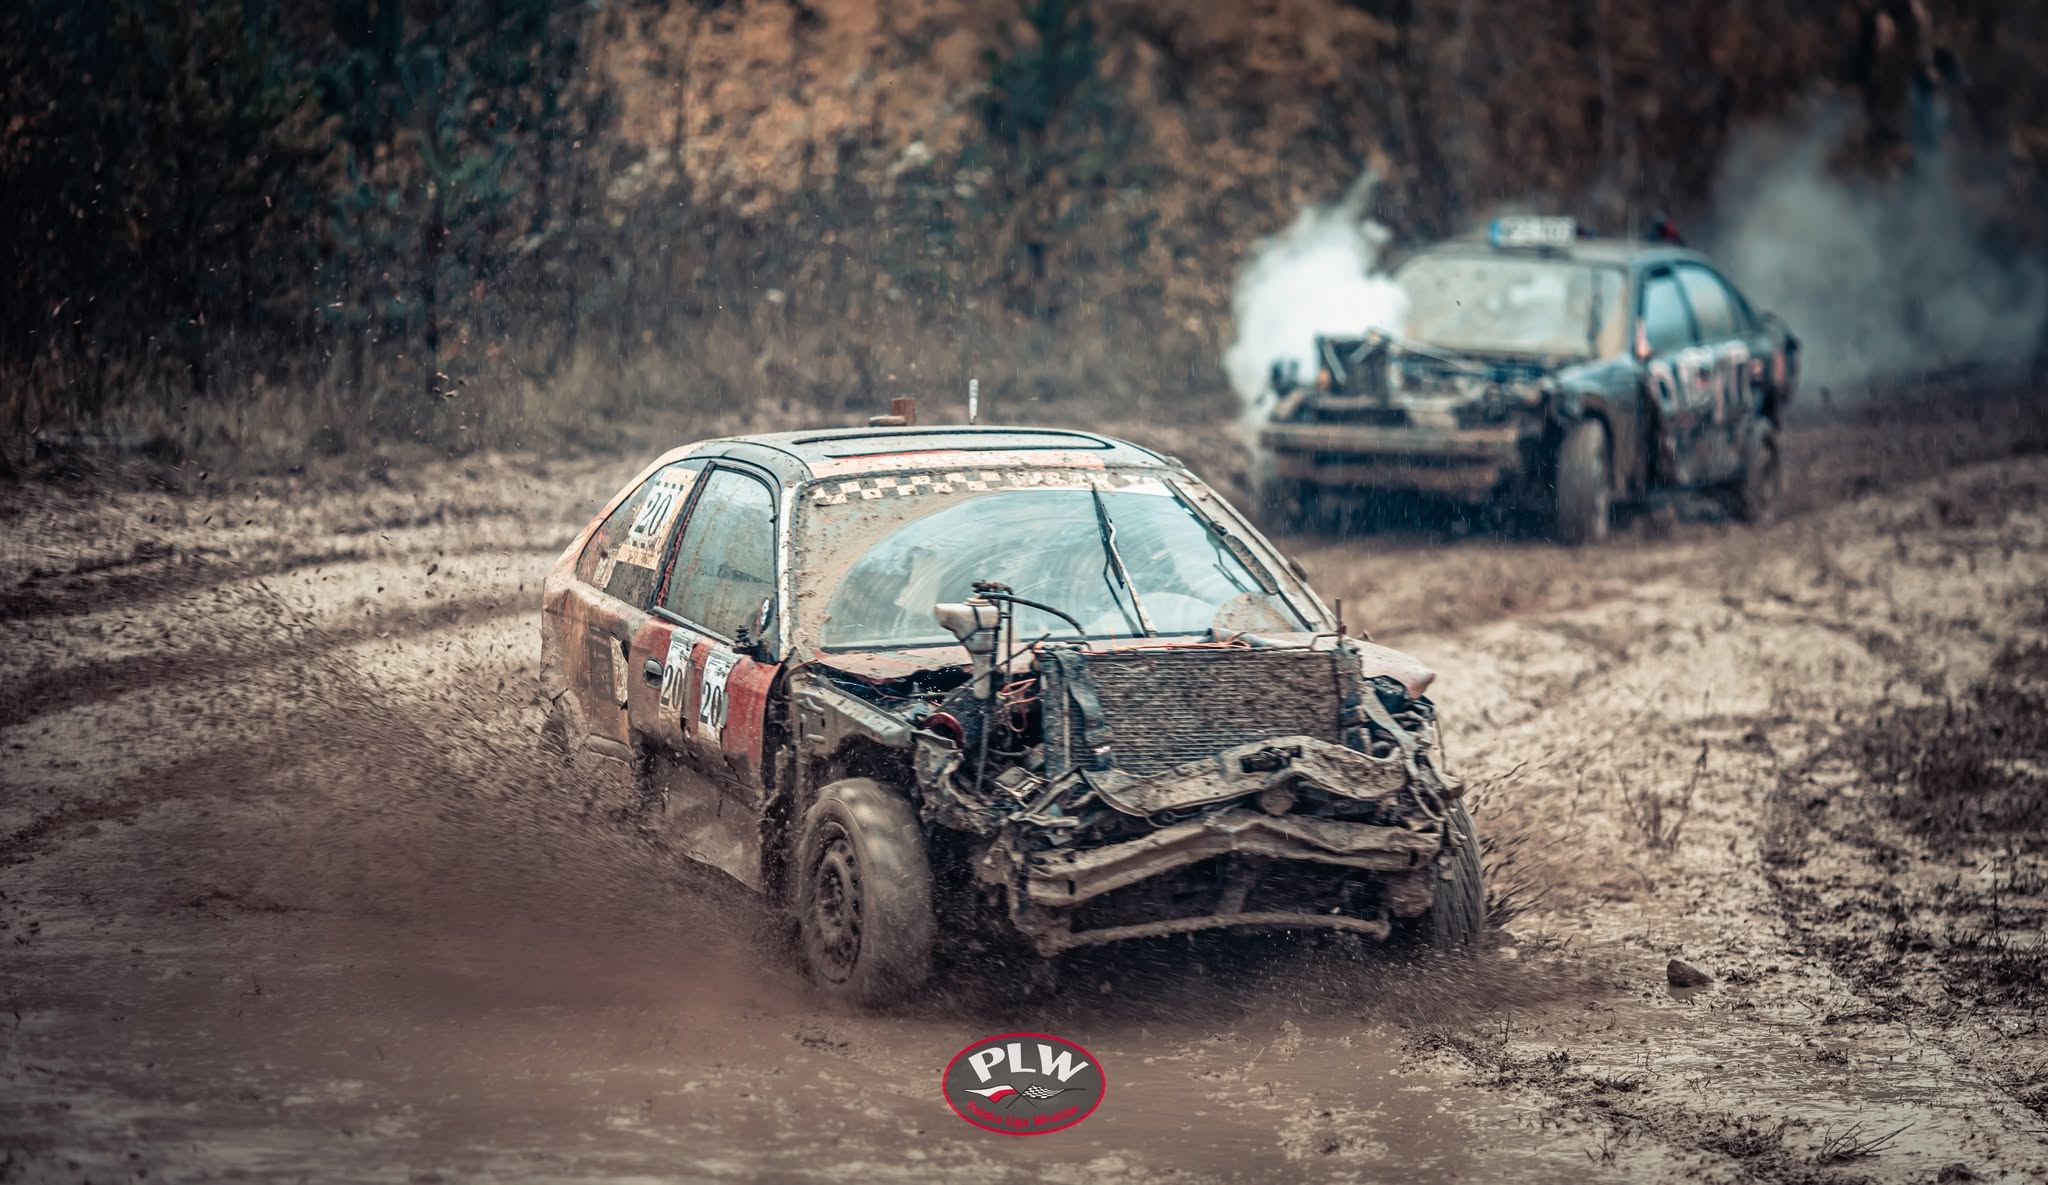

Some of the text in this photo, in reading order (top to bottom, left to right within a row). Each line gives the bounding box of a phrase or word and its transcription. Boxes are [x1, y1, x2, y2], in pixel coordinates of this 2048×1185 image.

[634, 492, 672, 537] 20
[661, 664, 683, 710] 20
[700, 681, 721, 728] 20
